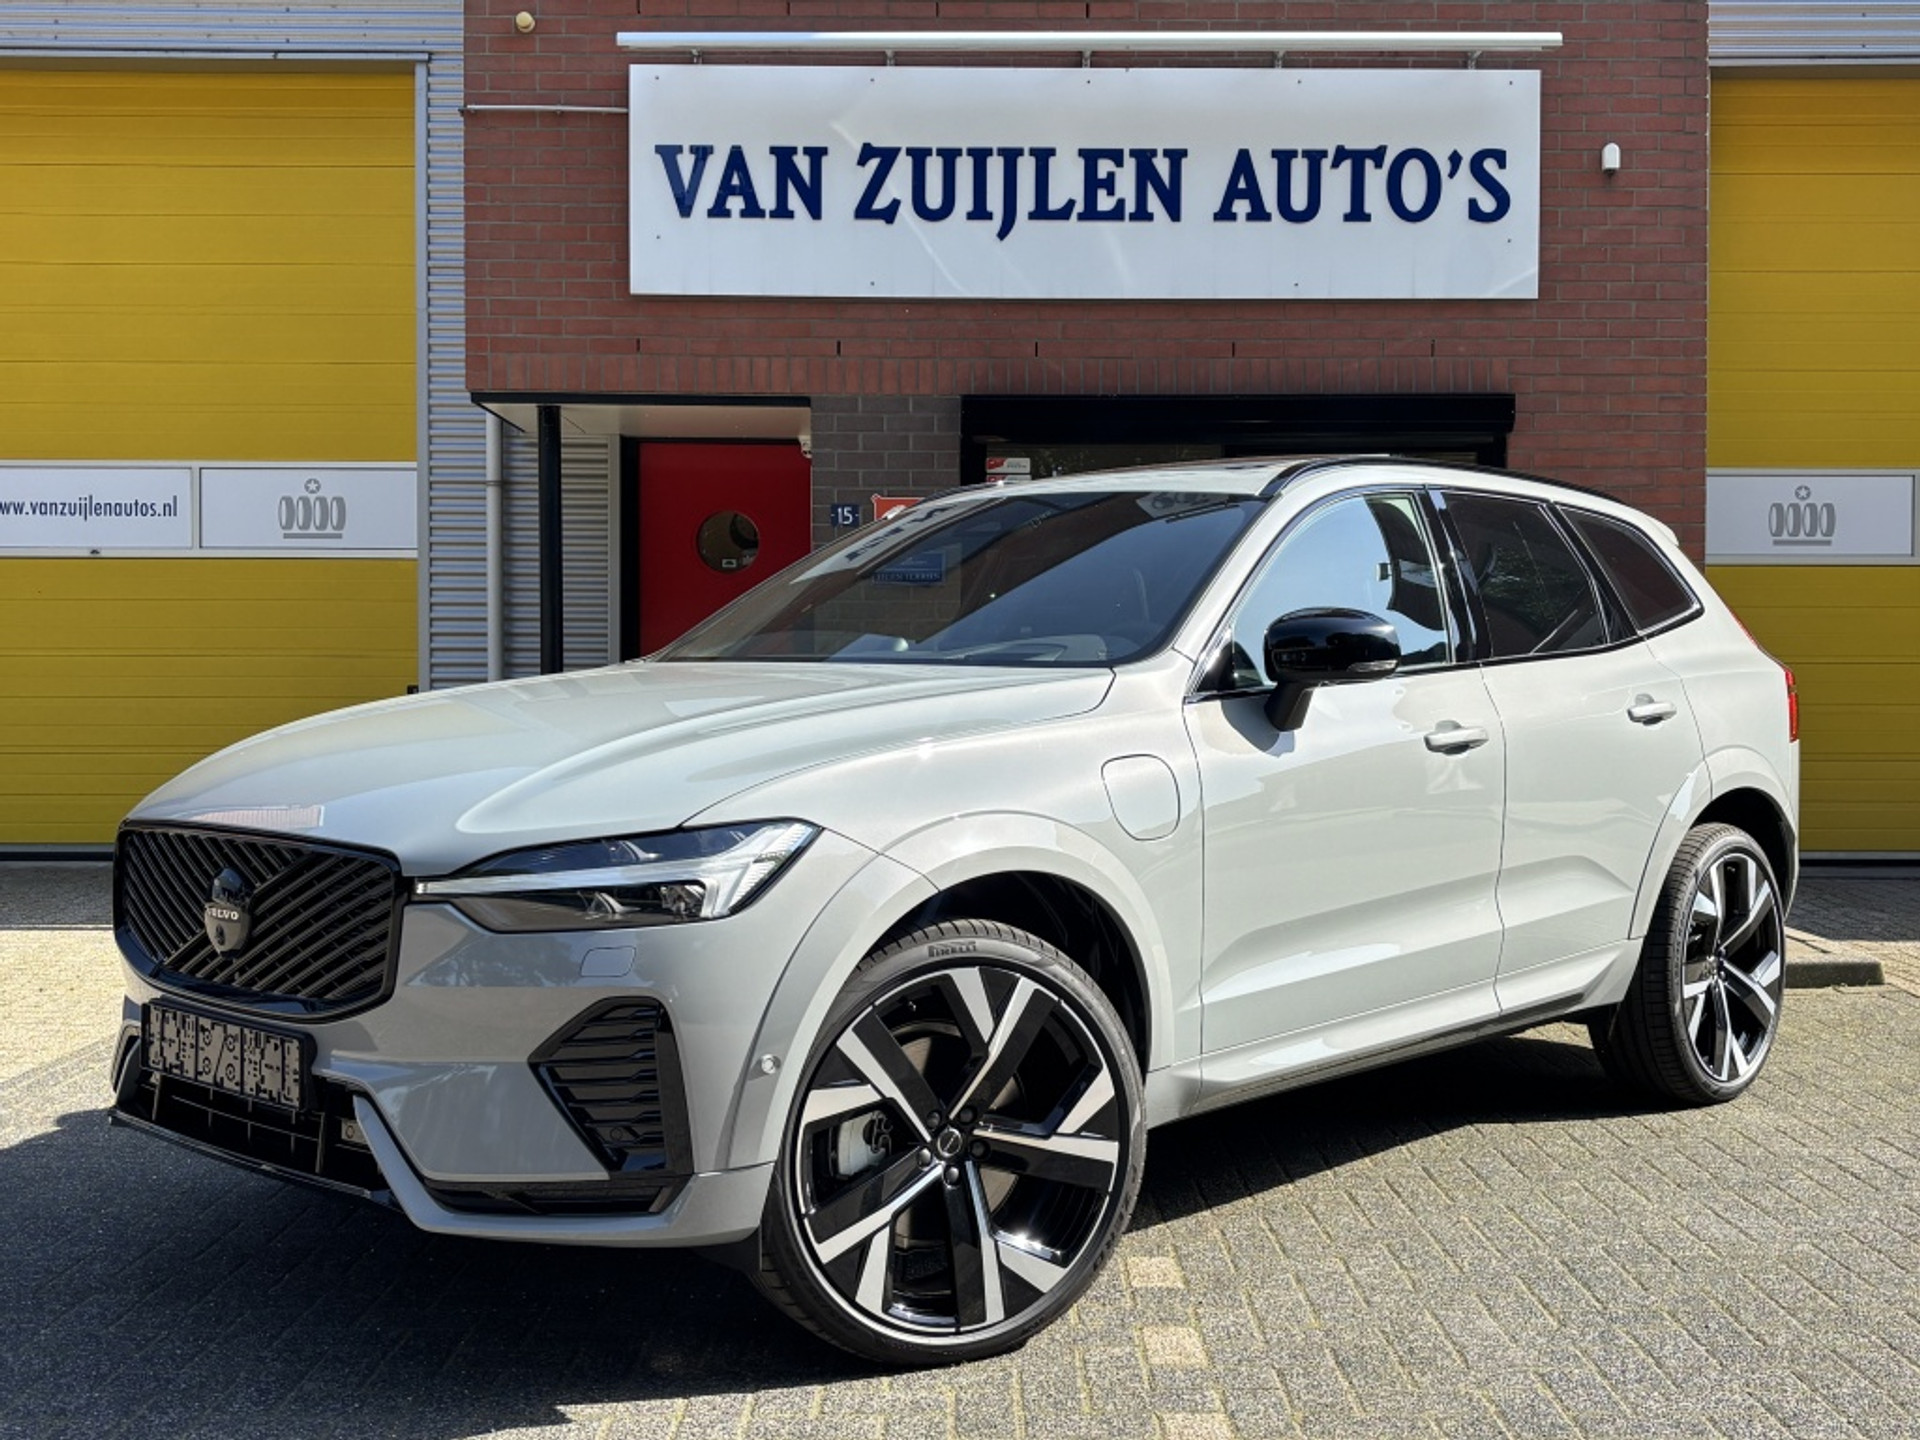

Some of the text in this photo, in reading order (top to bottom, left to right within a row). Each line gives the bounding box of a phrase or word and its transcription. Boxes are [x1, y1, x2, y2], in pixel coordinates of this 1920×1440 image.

[655, 142, 1511, 241] VAN ZUIJLEN AUTO'S
[837, 506, 854, 525] 15
[928, 940, 977, 958] PIRELLI
